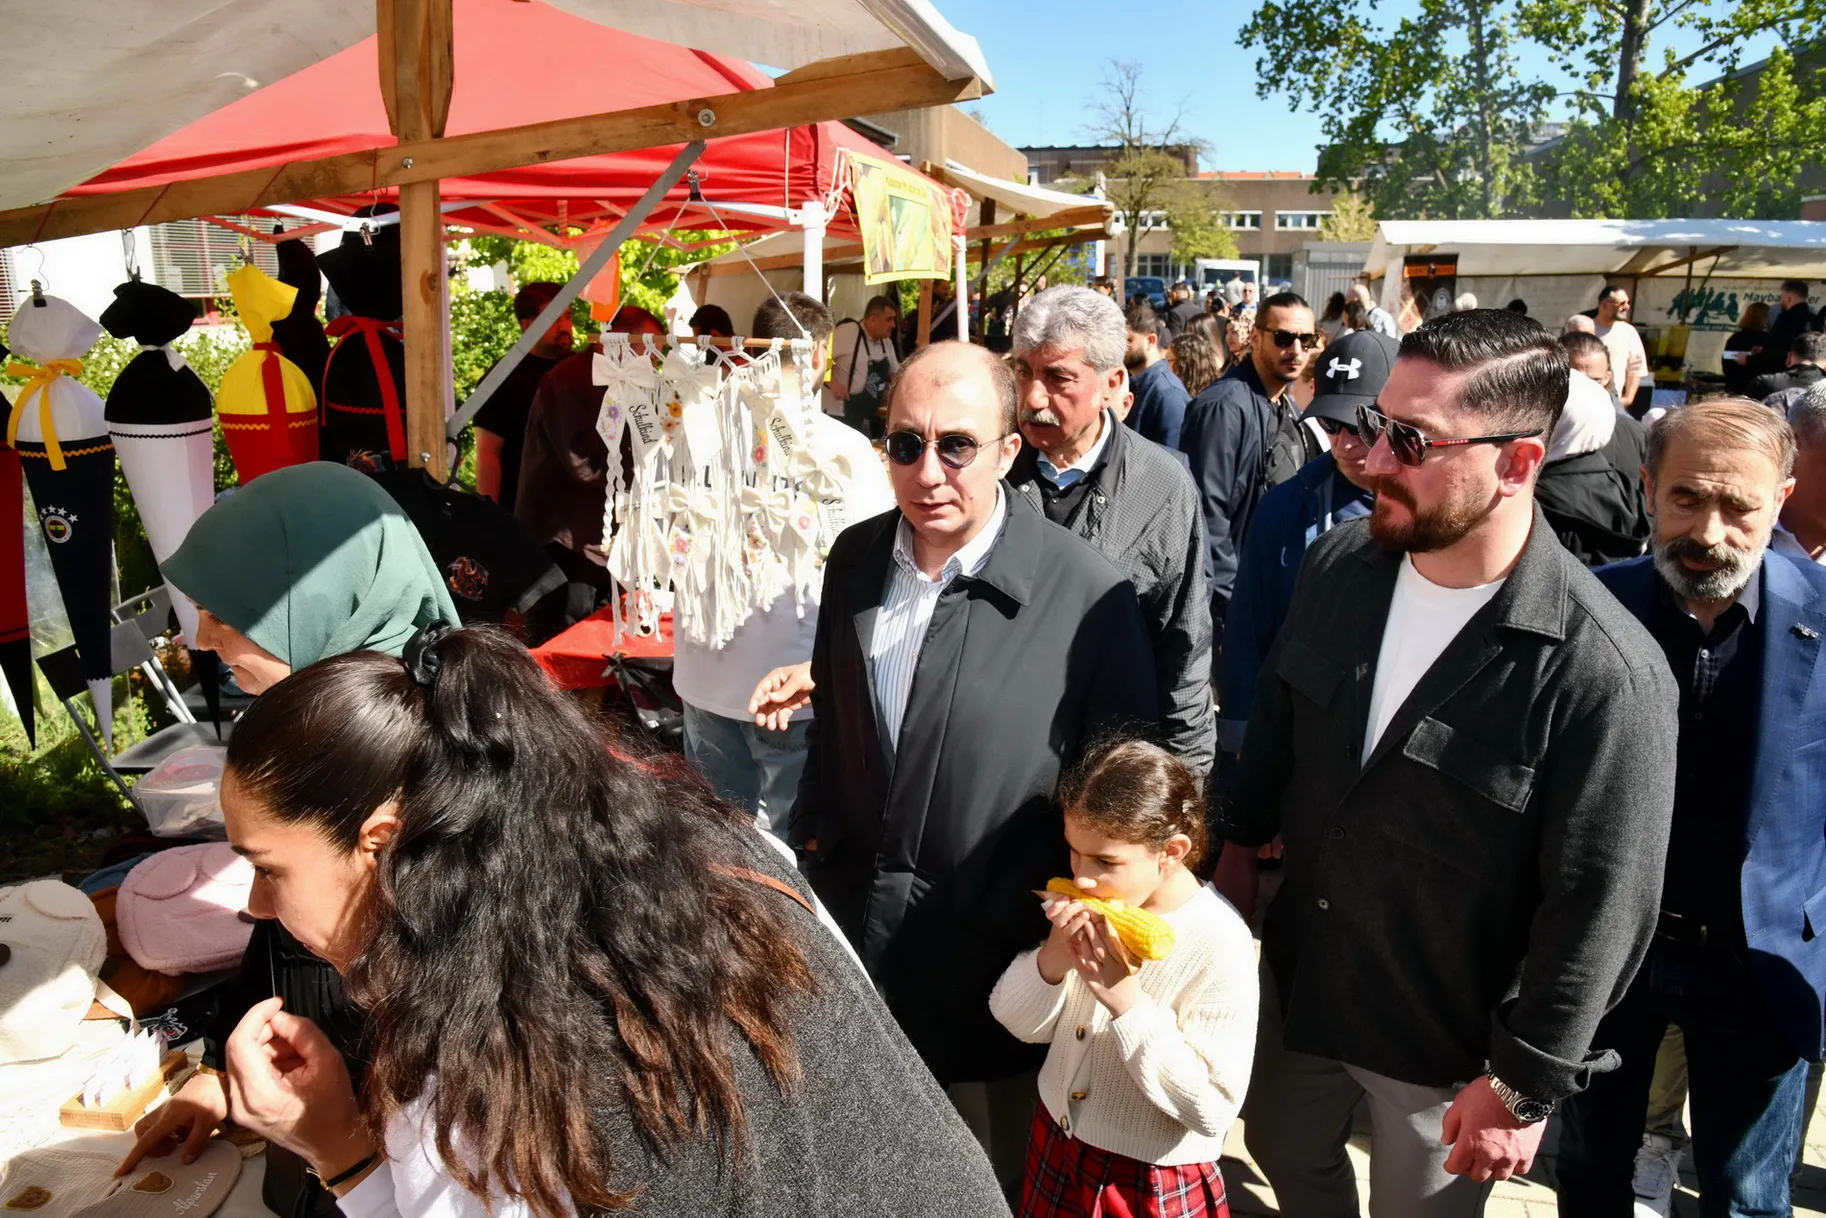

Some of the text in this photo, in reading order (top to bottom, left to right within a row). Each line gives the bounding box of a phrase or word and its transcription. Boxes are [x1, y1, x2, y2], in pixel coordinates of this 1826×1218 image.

[1743, 292, 1820, 304] Maybaer
[629, 404, 658, 445] Schulkind
[173, 1171, 218, 1215] Alparslan
